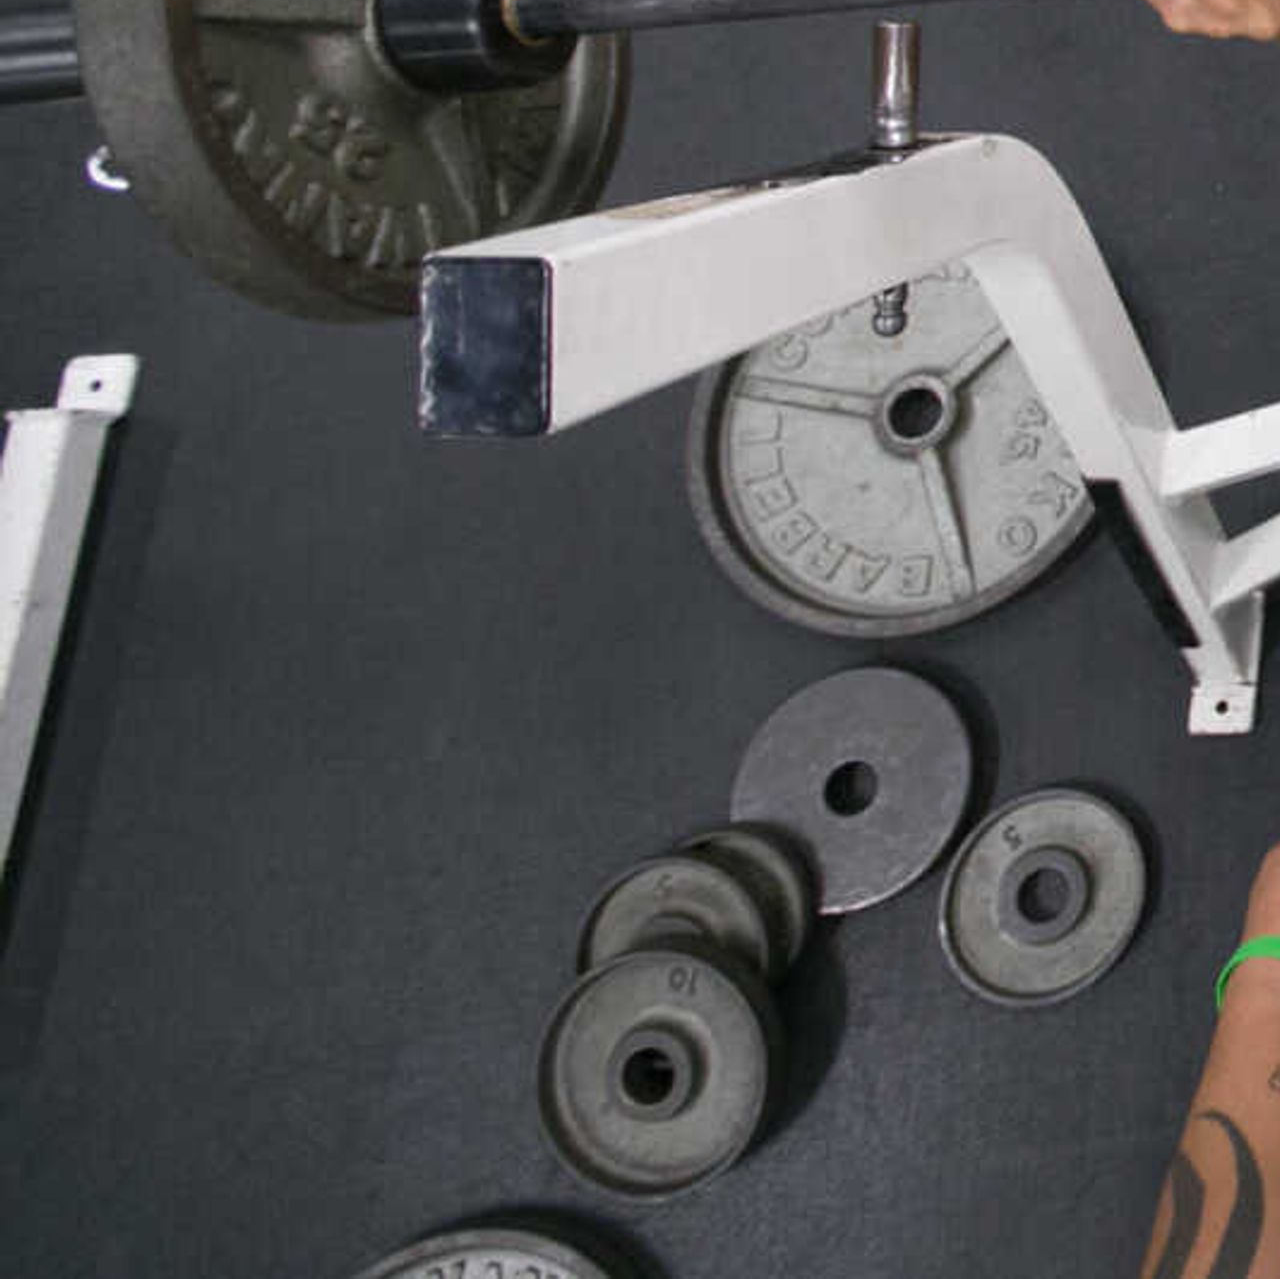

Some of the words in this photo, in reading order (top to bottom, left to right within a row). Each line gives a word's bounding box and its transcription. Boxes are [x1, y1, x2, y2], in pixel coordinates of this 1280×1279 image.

[736, 409, 937, 599] BARBELL
[1002, 825, 1025, 850] 5
[666, 967, 698, 994] 10
